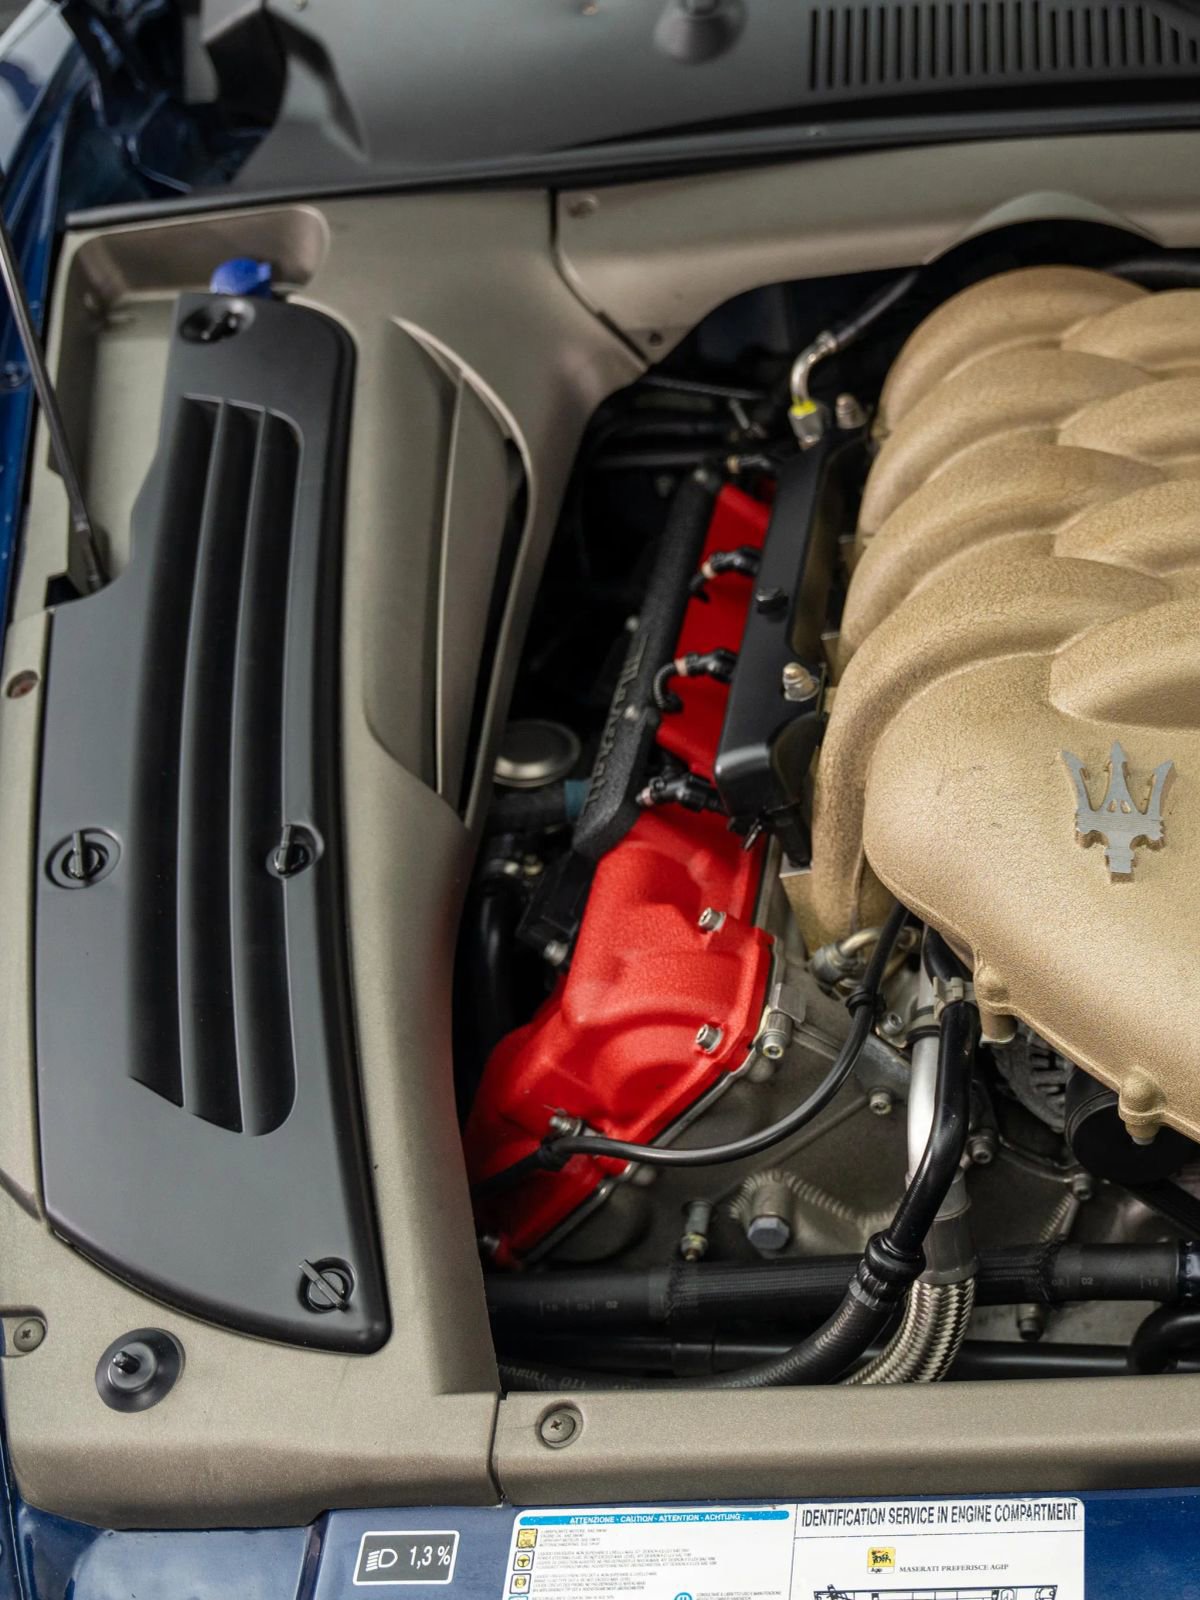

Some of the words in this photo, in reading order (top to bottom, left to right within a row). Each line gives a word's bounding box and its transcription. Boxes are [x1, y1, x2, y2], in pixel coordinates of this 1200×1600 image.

[569, 1515, 615, 1525] ATTENZIONE
[620, 1514, 654, 1523] CAUTION
[658, 1513, 700, 1522] ATTENTION
[704, 1512, 741, 1521] ACHTUNG
[801, 1507, 886, 1527] IDENTIFICATION
[888, 1506, 935, 1524] SERVICE
[937, 1505, 949, 1523] IN
[951, 1504, 992, 1523] ENGINE
[994, 1502, 1079, 1522] COMPARTMENT
[409, 1545, 433, 1570] 1,3
[437, 1545, 451, 1567] %
[899, 1565, 939, 1573] MASERATI
[941, 1564, 989, 1572] PREFERISCE
[990, 1563, 1009, 1571] AGIP
